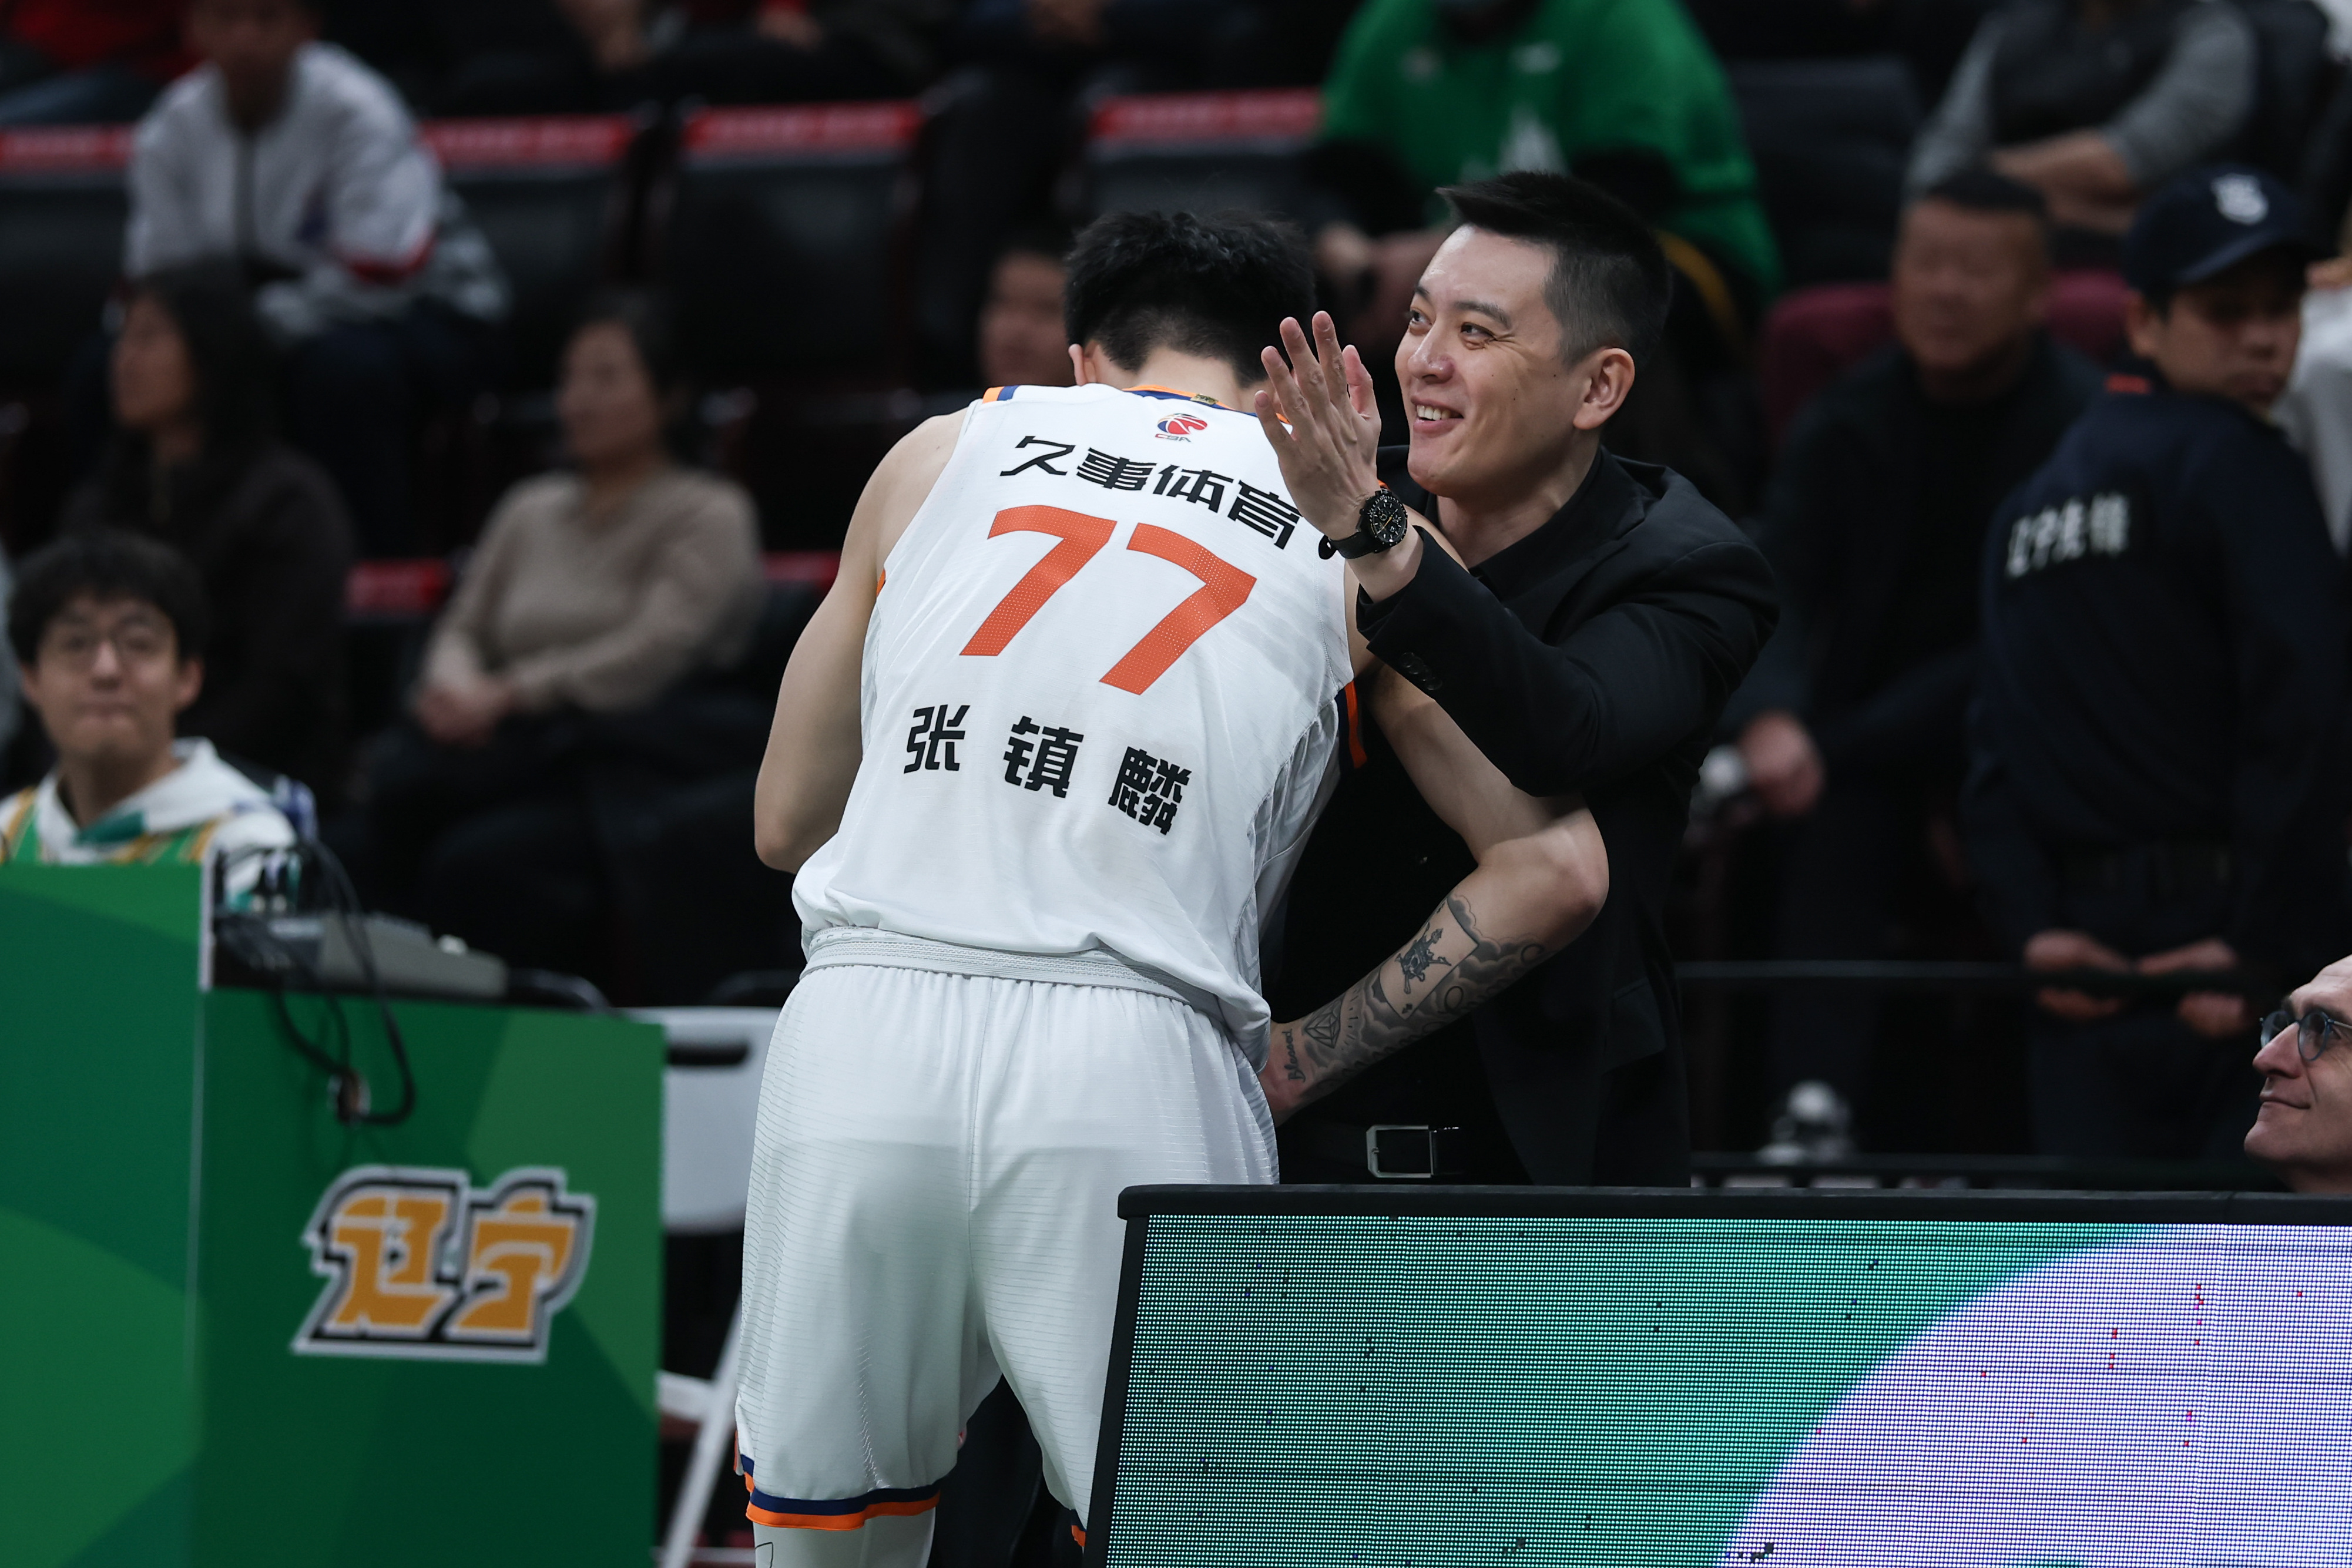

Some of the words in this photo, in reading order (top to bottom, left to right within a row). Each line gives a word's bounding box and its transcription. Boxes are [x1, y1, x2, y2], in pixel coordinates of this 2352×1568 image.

[1155, 433, 1191, 442] CBA
[999, 435, 1301, 550] 久事体育
[959, 505, 1257, 696] 77
[1282, 1028, 1306, 1083] Blessed
